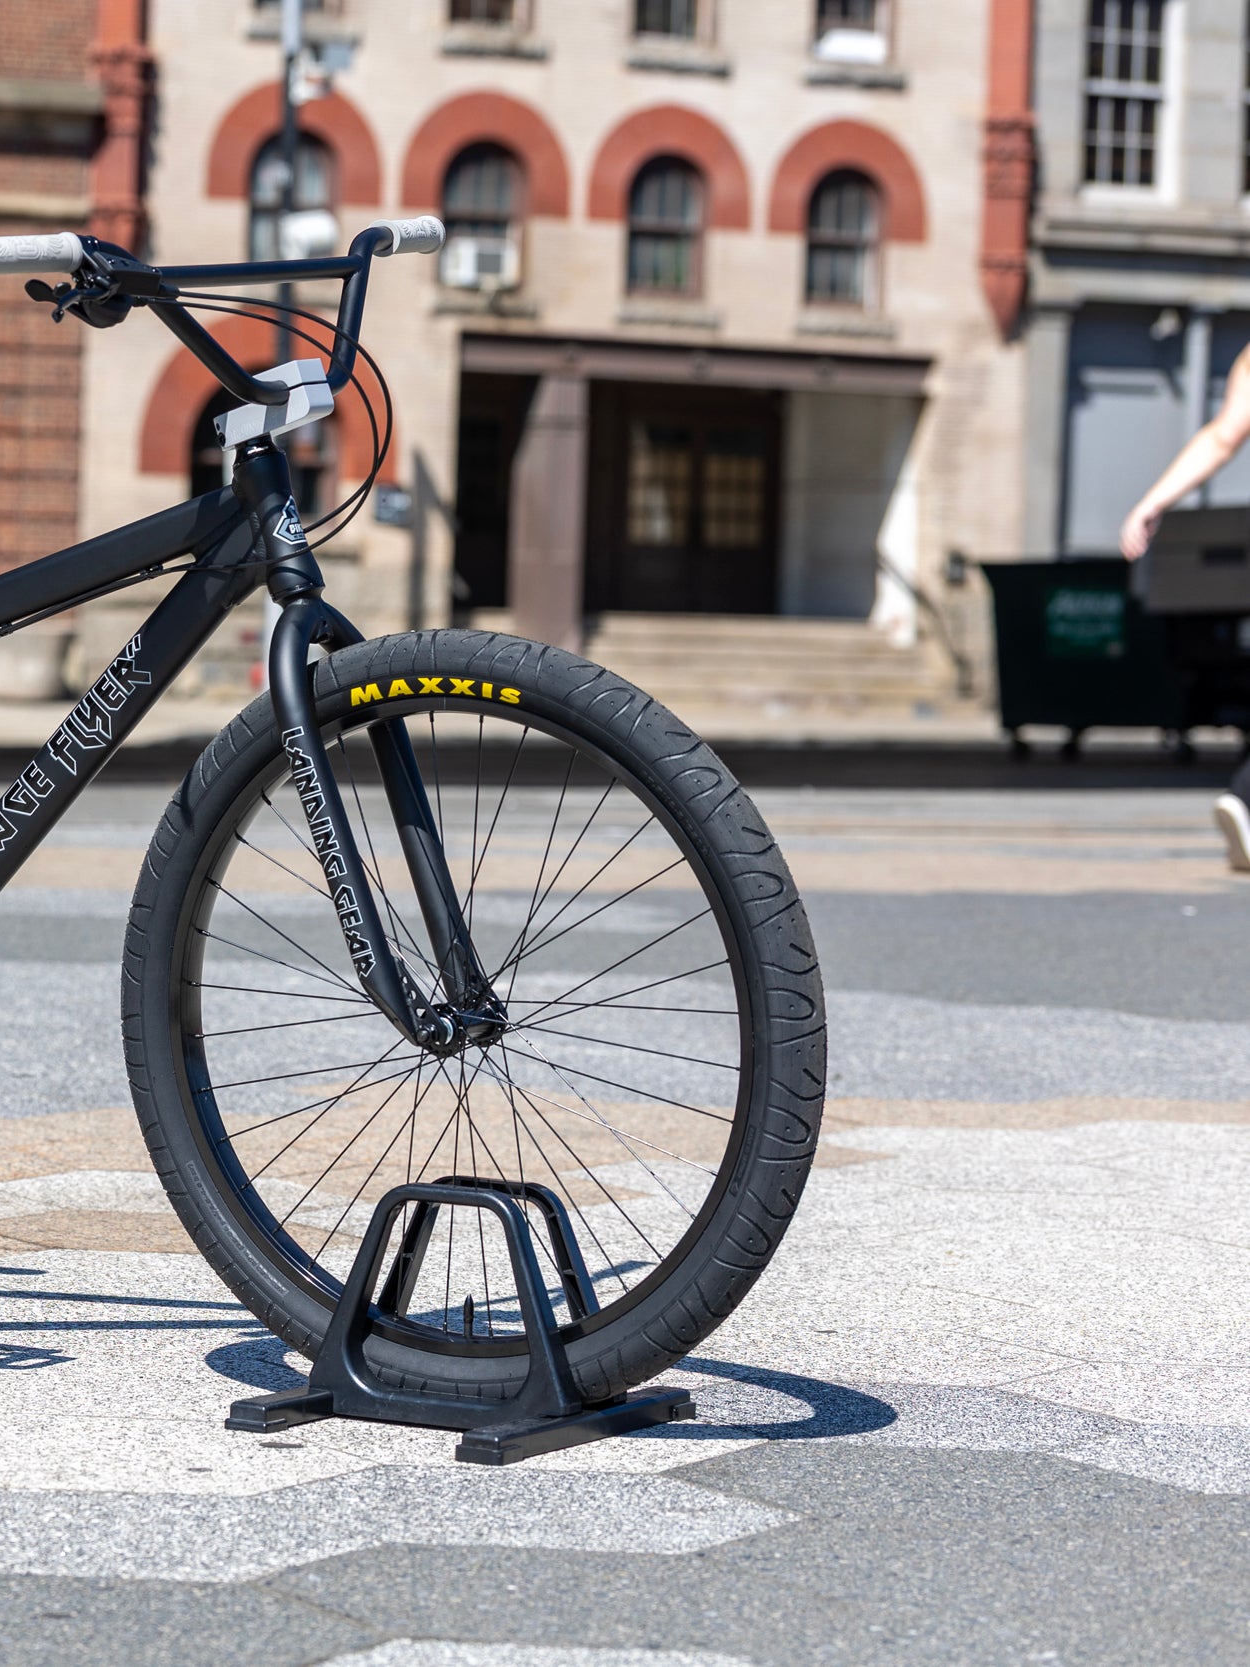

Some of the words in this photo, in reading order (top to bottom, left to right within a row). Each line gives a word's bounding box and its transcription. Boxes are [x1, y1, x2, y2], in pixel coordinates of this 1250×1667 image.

[47, 633, 152, 775] FLYER"
[350, 676, 522, 707] MAXXIS
[281, 726, 348, 879] LANDING
[334, 883, 376, 978] GEAR
